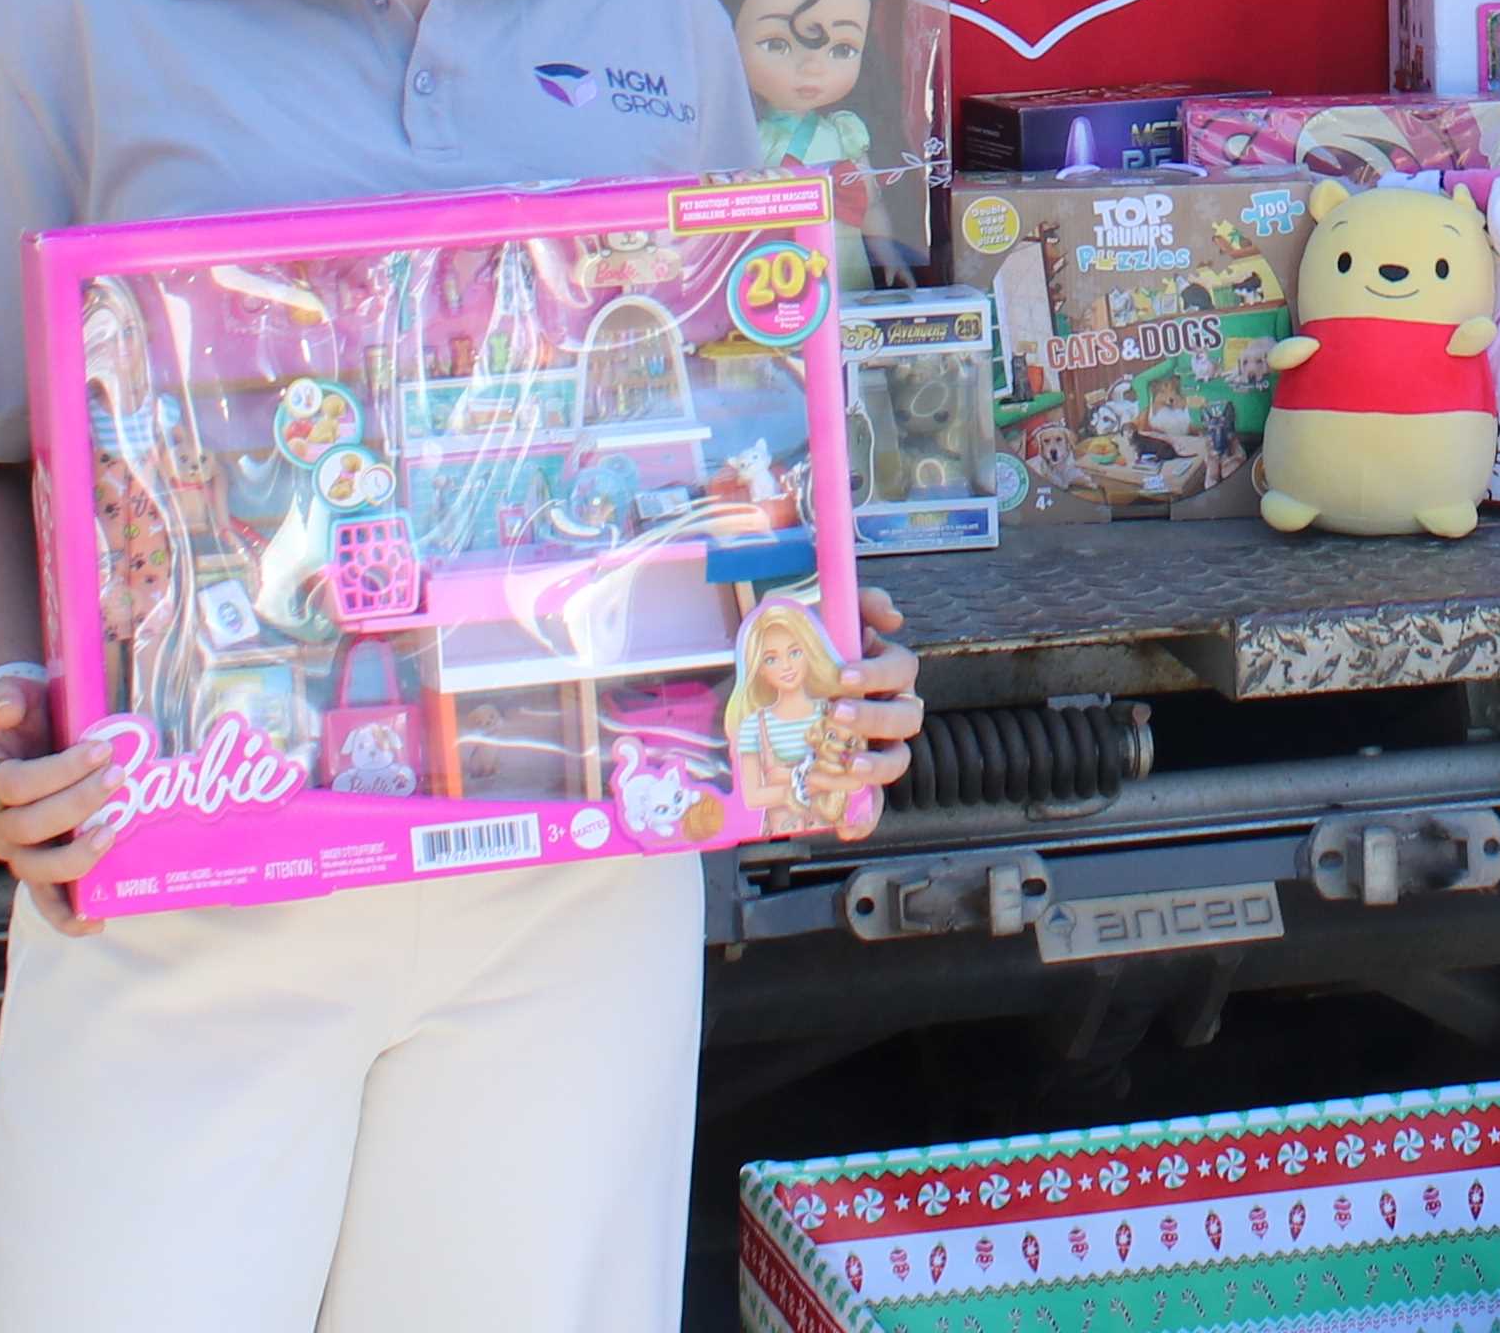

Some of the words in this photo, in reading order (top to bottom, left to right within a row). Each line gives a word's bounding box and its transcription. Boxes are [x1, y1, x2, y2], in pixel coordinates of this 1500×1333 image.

[604, 67, 668, 96] NGM
[611, 92, 696, 123] GROUP
[1092, 193, 1174, 229] TOP
[1258, 200, 1287, 218] 100
[1094, 223, 1174, 247] TRUMPS
[1076, 245, 1191, 272] Puzzles
[746, 250, 829, 307] 20+
[1046, 330, 1120, 372] CATS
[1121, 337, 1140, 361] &
[1138, 314, 1224, 361] DOGS
[547, 823, 566, 843] 3+
[572, 818, 610, 839] MATTEL
